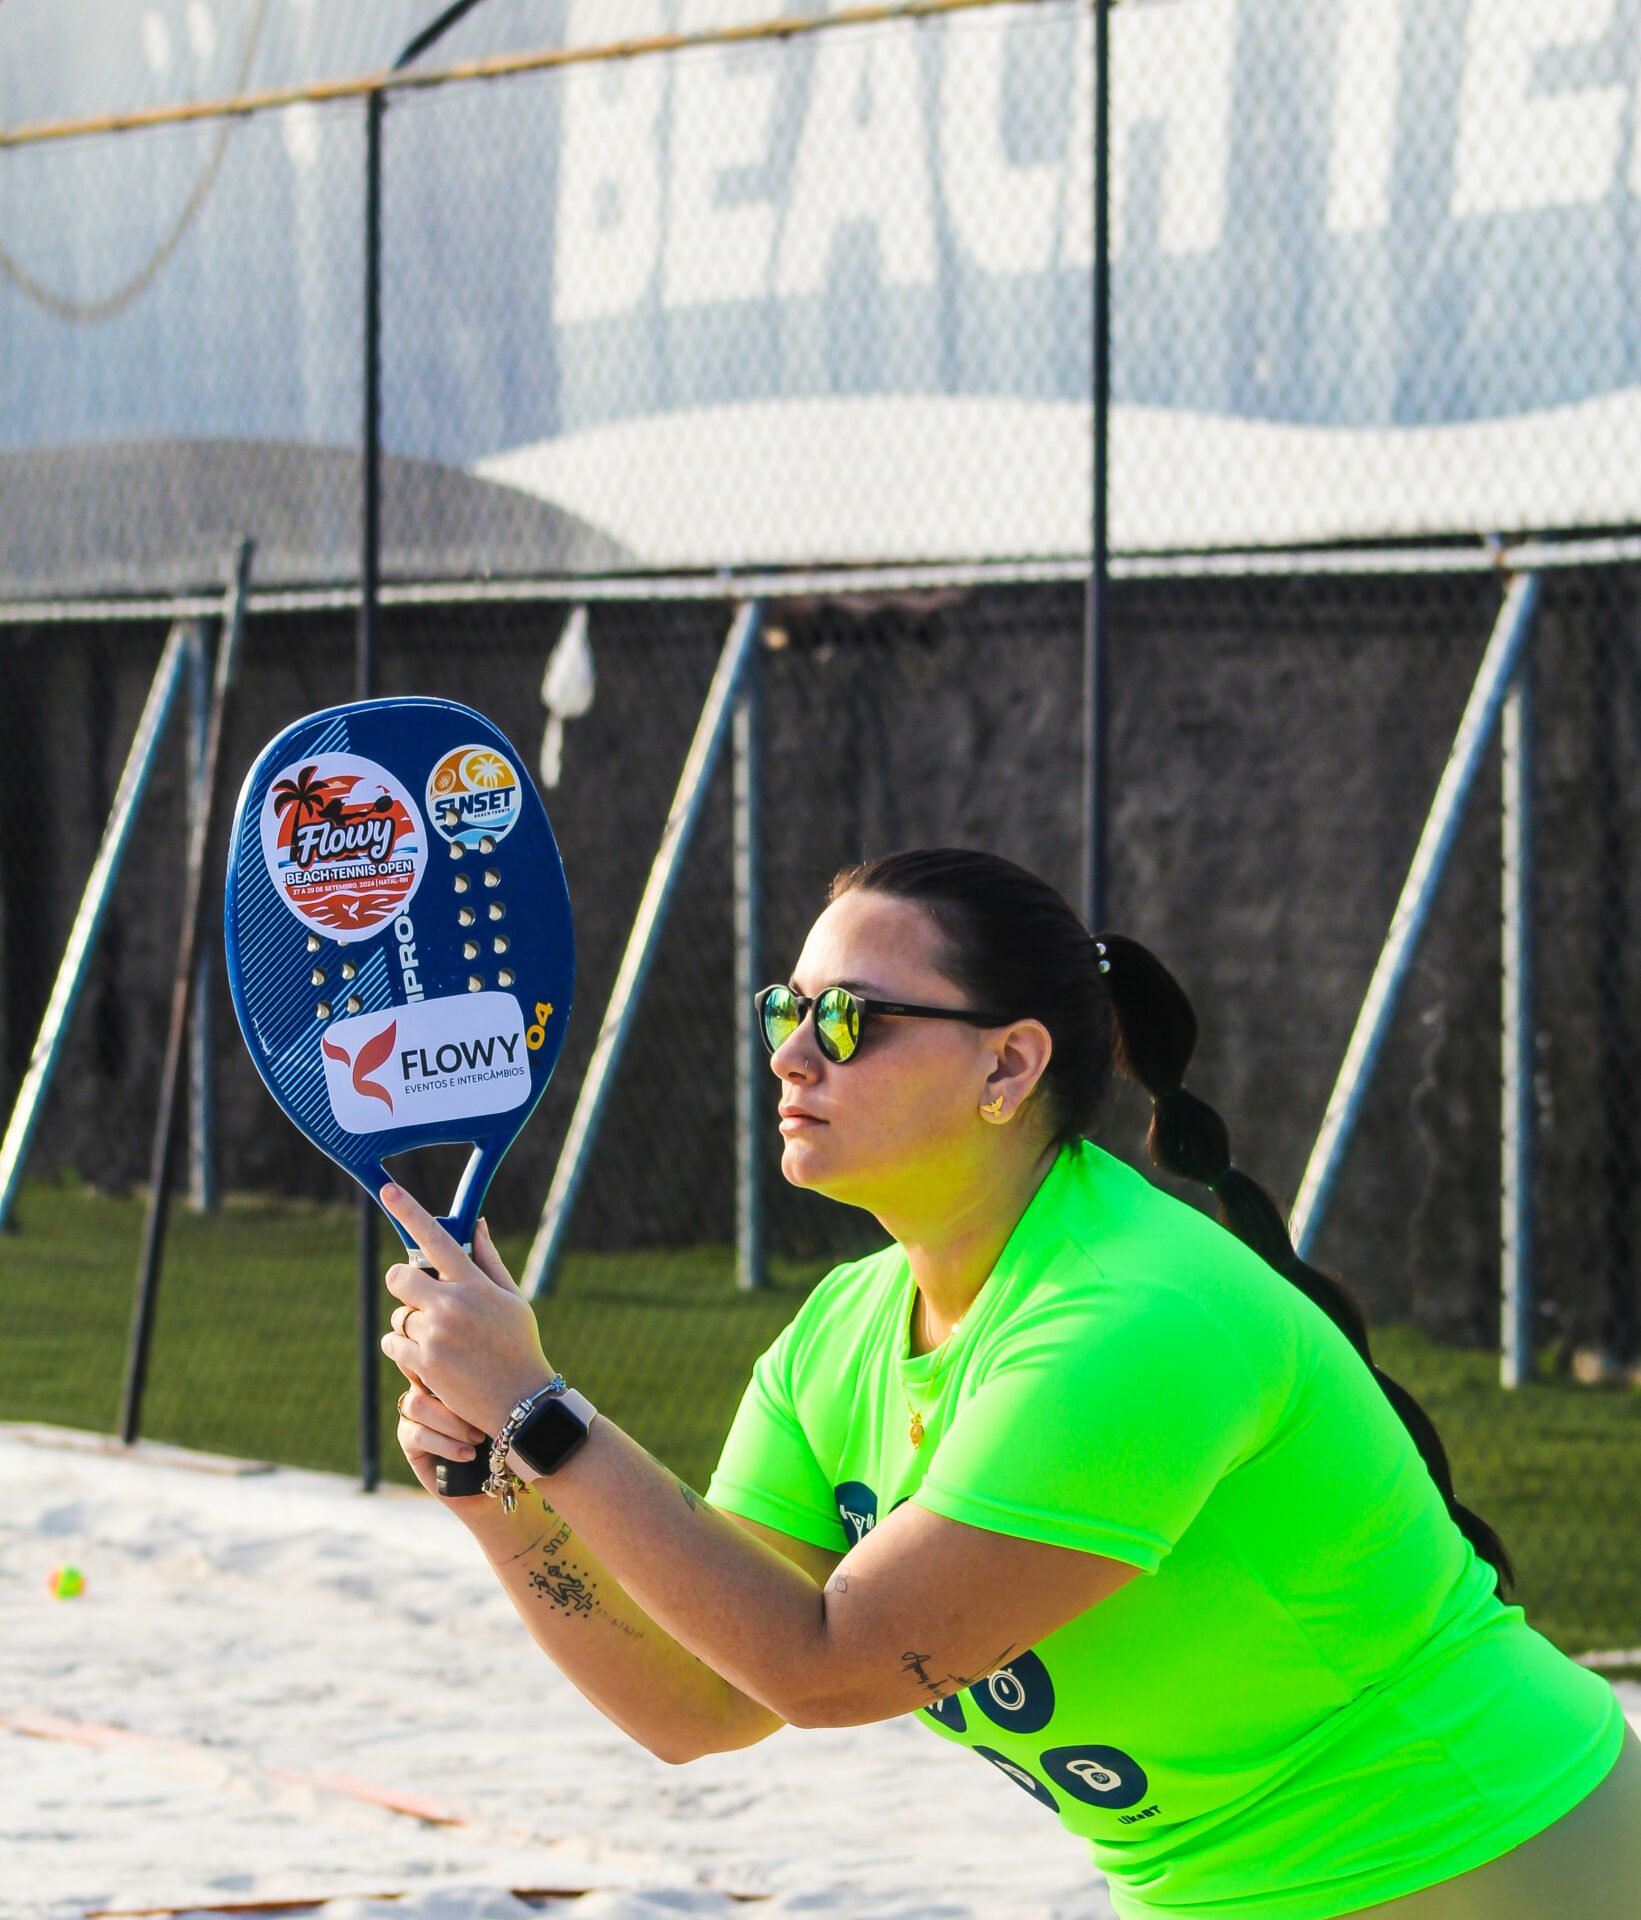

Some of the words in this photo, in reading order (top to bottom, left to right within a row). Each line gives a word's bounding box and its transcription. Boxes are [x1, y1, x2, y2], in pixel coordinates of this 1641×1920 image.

[552, 0, 1241, 325] BEACH
[435, 785, 516, 821] SNSET
[298, 819, 392, 865] Flowy
[286, 868, 330, 885] BEACH
[331, 864, 377, 881] TENNIS
[377, 860, 413, 875] OPEN
[359, 880, 375, 889] 2024
[525, 1001, 554, 1051] 04
[400, 1032, 520, 1080] FLOWY
[404, 1078, 448, 1094] EVENTOS
[450, 1077, 455, 1087] E
[456, 1066, 525, 1086] INTERCÂMBIOS
